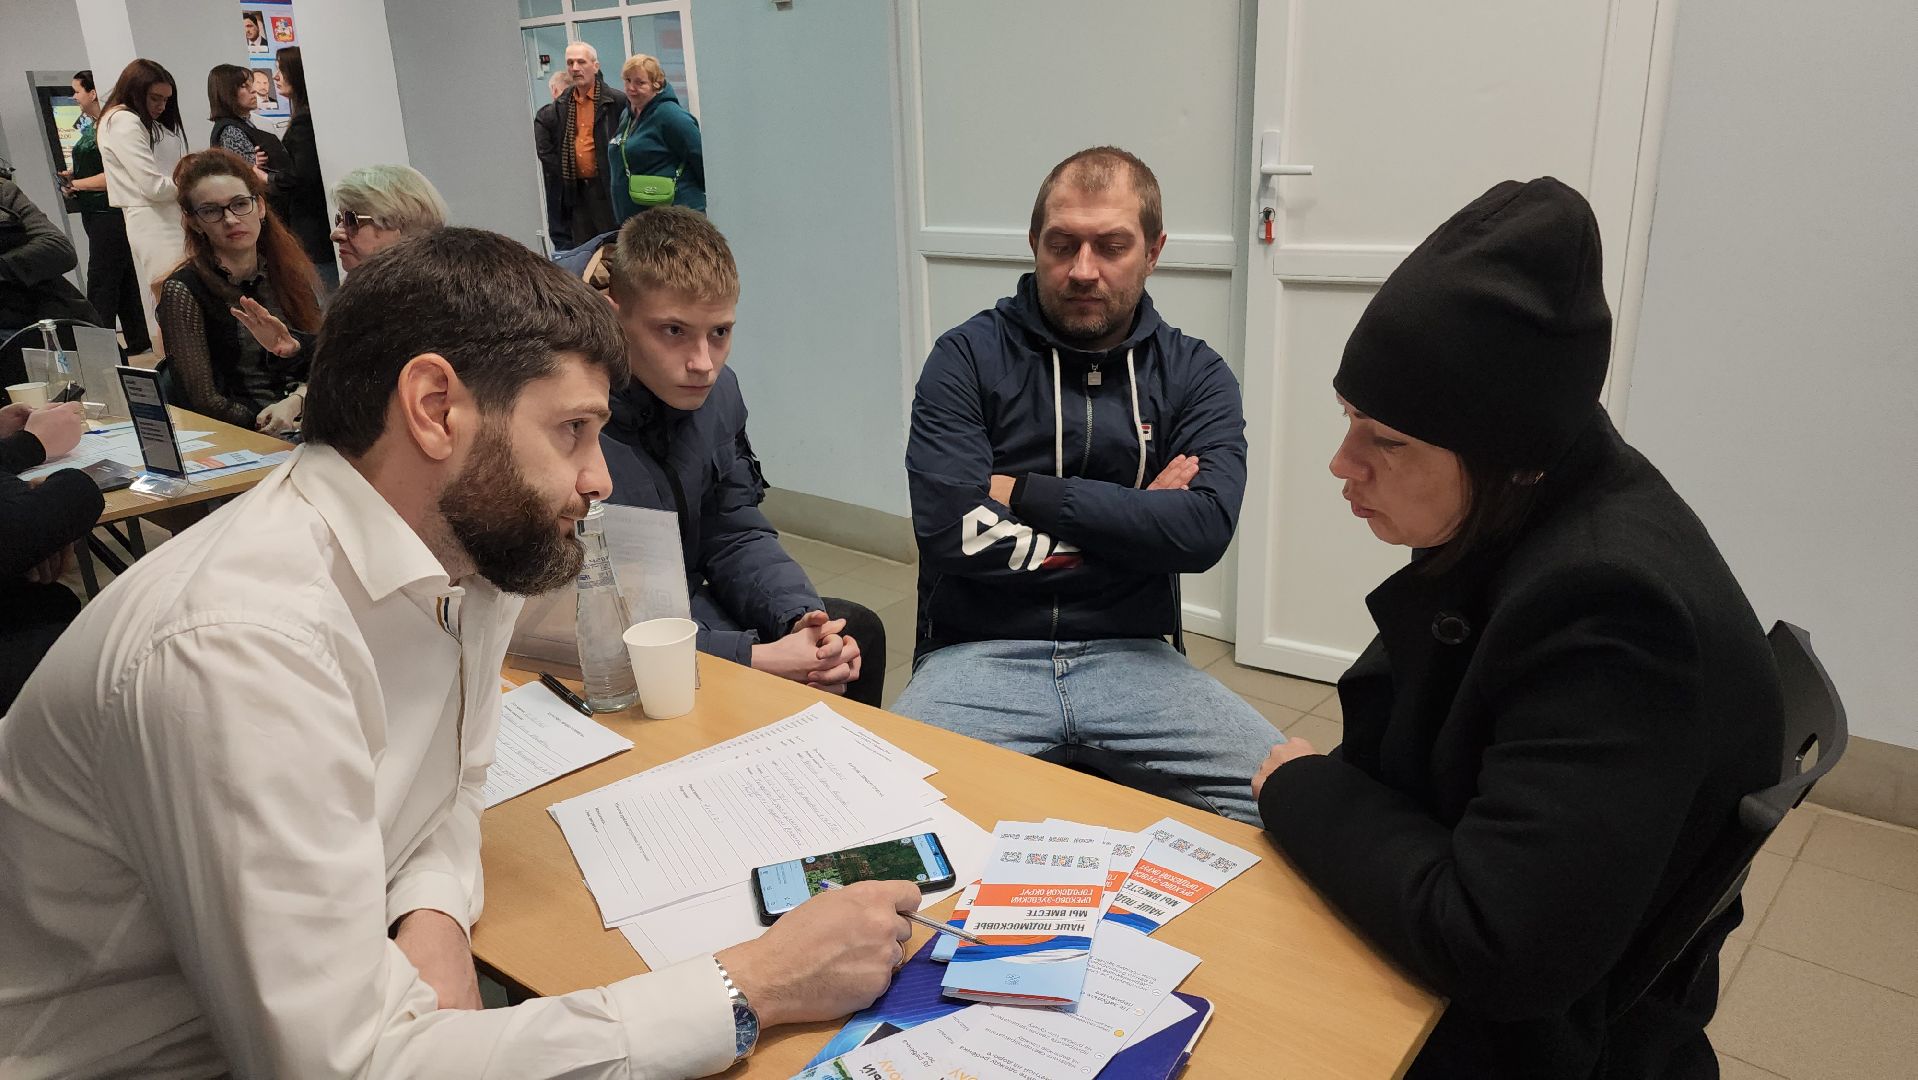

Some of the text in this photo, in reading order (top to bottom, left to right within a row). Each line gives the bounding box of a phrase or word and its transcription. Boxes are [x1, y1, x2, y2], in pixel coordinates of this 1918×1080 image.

[1123, 881, 1162, 901] ВМЕСТЕ
[1159, 895, 1180, 908] МЫ
[1025, 909, 1066, 917] ВМЕСТЕ
[1133, 901, 1164, 918] НАШЕ
[973, 922, 1084, 931] НАШЕ ПОДМОСКОВЬЕ
